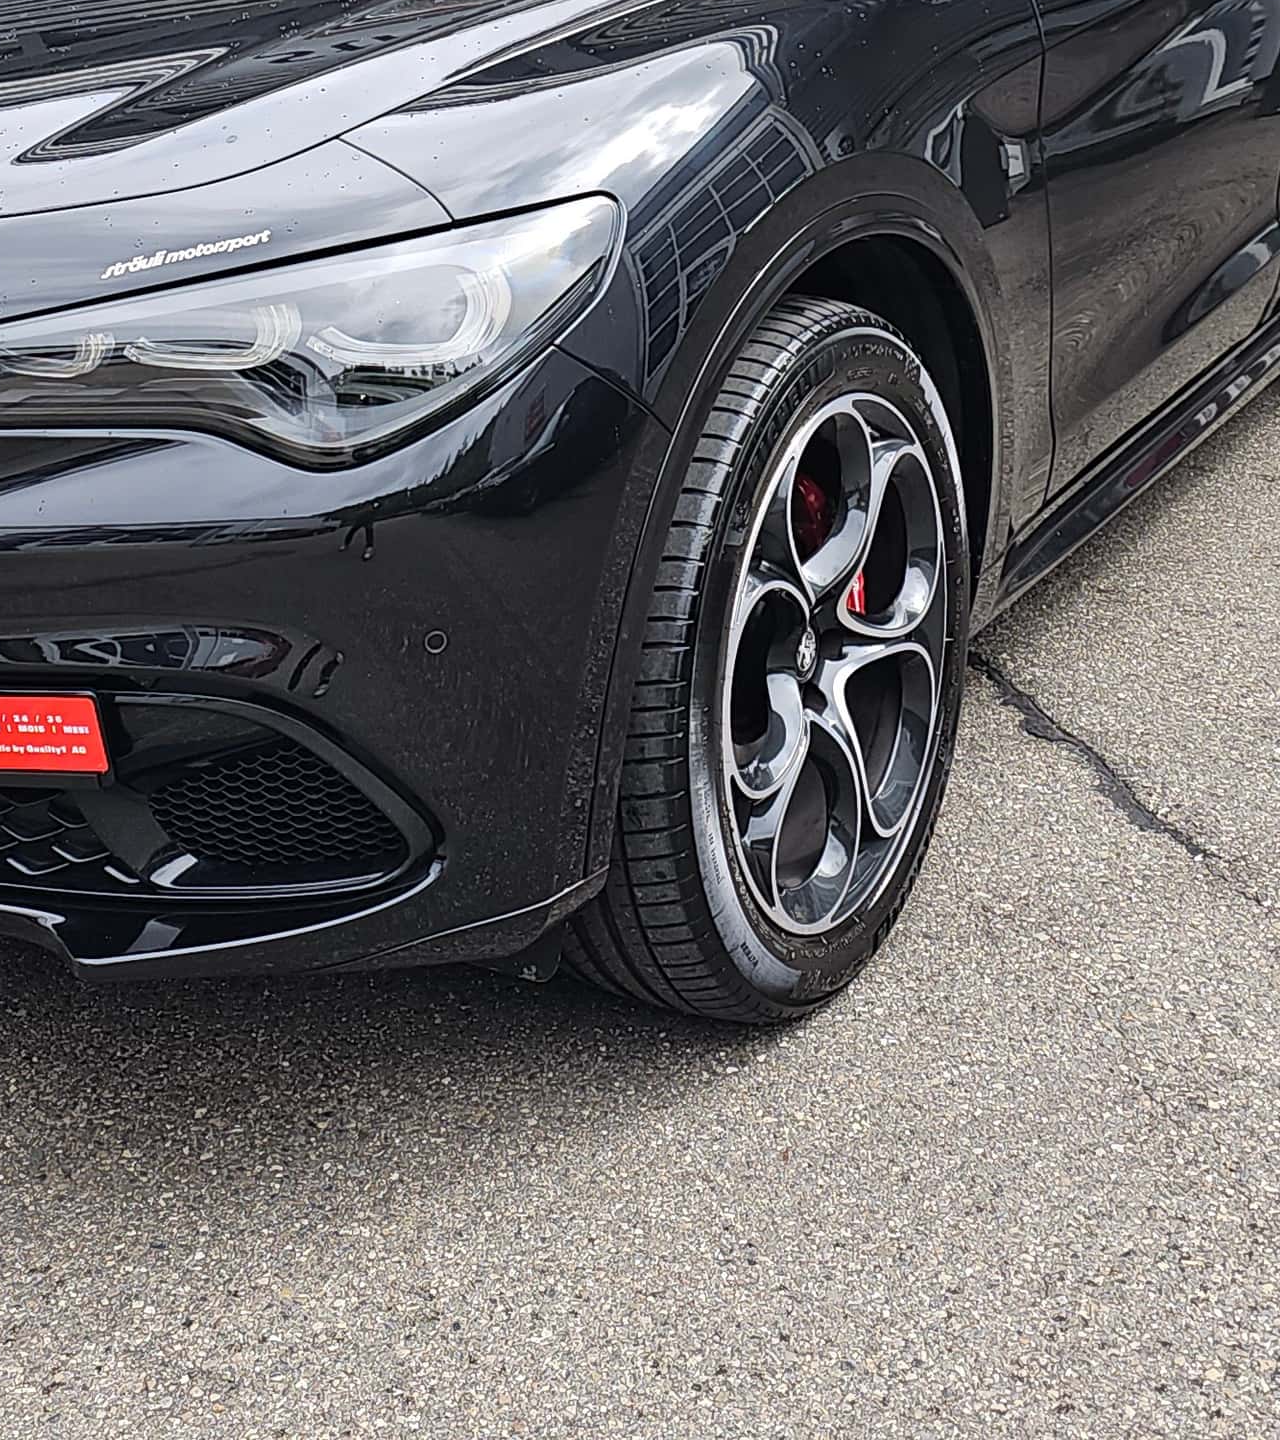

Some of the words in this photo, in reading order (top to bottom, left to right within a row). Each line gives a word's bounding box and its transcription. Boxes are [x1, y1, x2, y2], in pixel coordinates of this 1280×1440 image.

[163, 229, 271, 265] motorsport
[13, 744, 25, 754] by
[71, 746, 87, 754] AG
